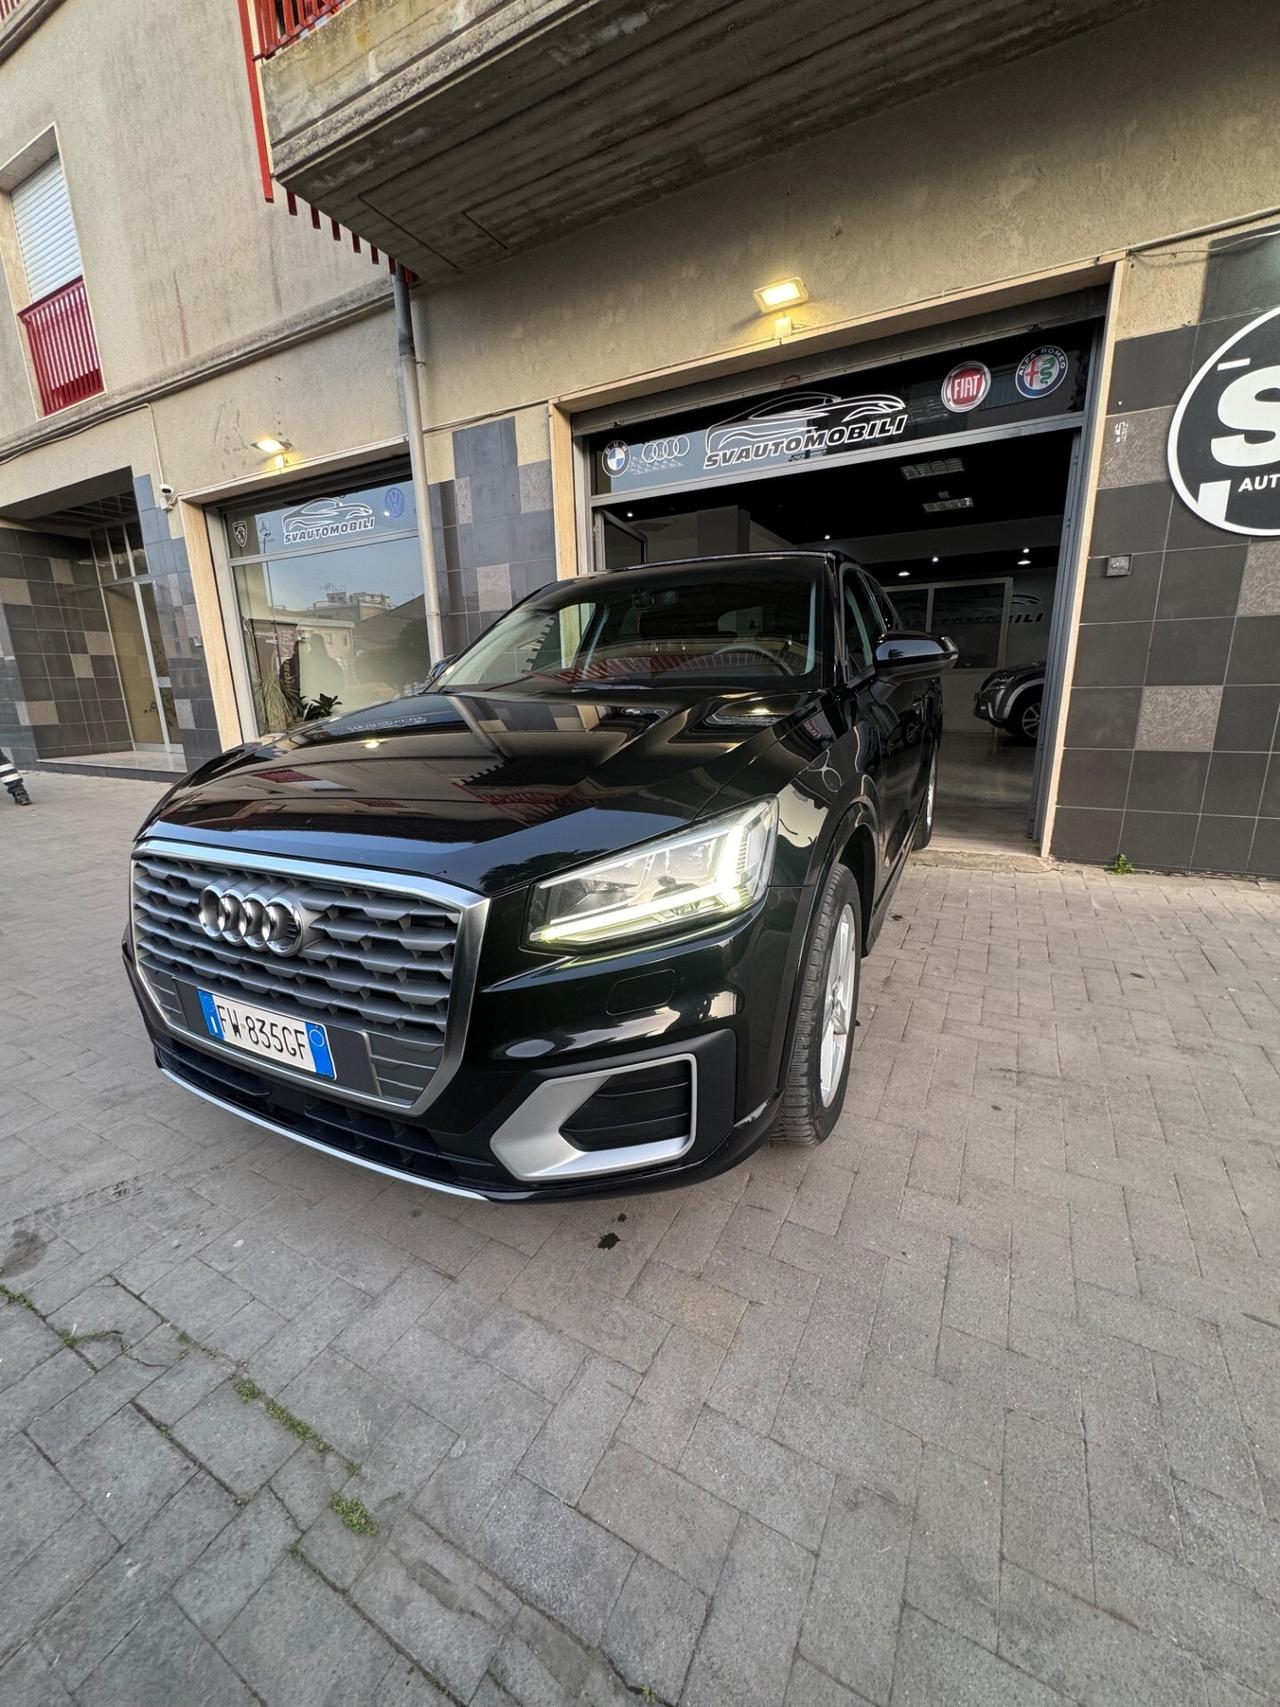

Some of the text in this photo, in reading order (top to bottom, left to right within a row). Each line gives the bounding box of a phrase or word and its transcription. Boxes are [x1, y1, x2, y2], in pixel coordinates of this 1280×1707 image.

[1041, 347, 1066, 370] ROMEO
[953, 375, 981, 400] FIAT
[703, 415, 908, 470] SVAUTOMOBILI
[284, 517, 375, 545] SVAUTOMOBILI
